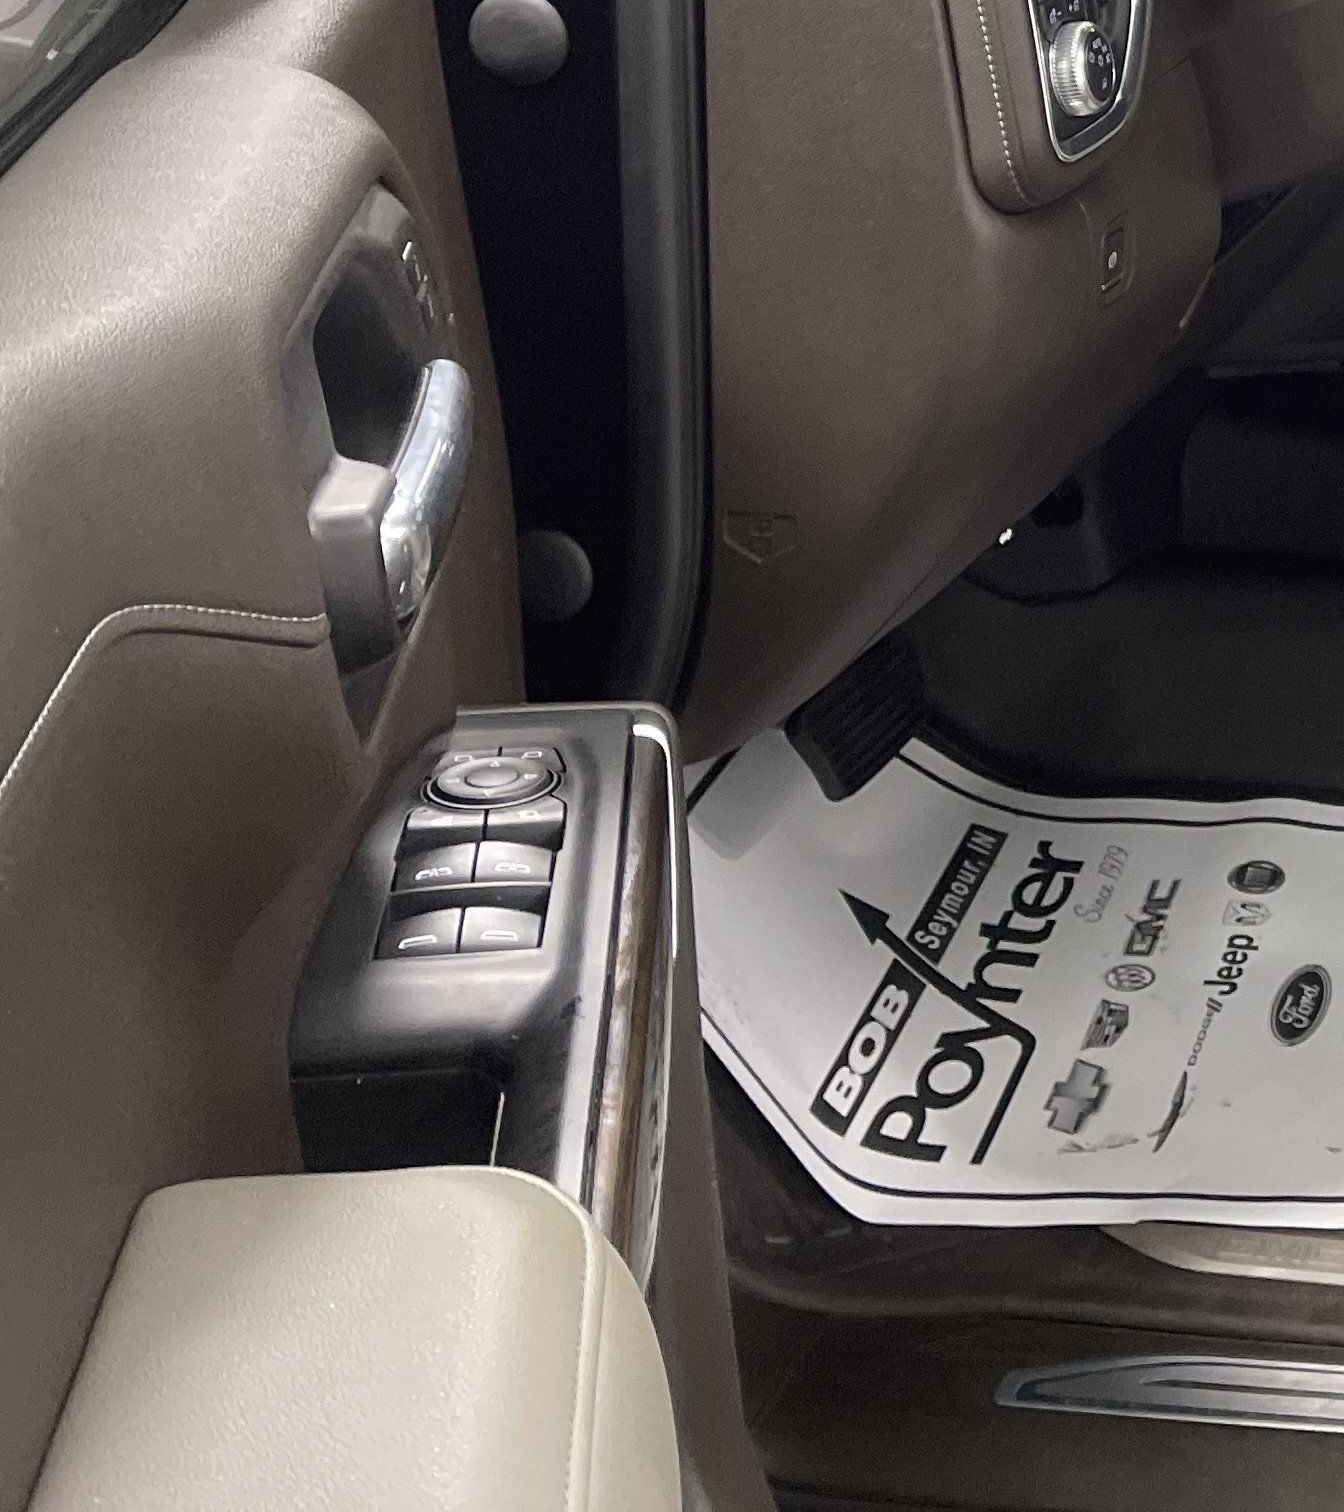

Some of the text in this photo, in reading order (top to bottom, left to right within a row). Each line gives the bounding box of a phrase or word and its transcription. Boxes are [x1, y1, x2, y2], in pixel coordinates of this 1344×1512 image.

[914, 829, 998, 950] Seymour, IN
[1123, 878, 1182, 957] GMC
[860, 840, 1085, 1165] Poynter
[1203, 933, 1260, 997] Jeep
[1279, 982, 1321, 1030] Ford
[822, 985, 912, 1118] BOB
